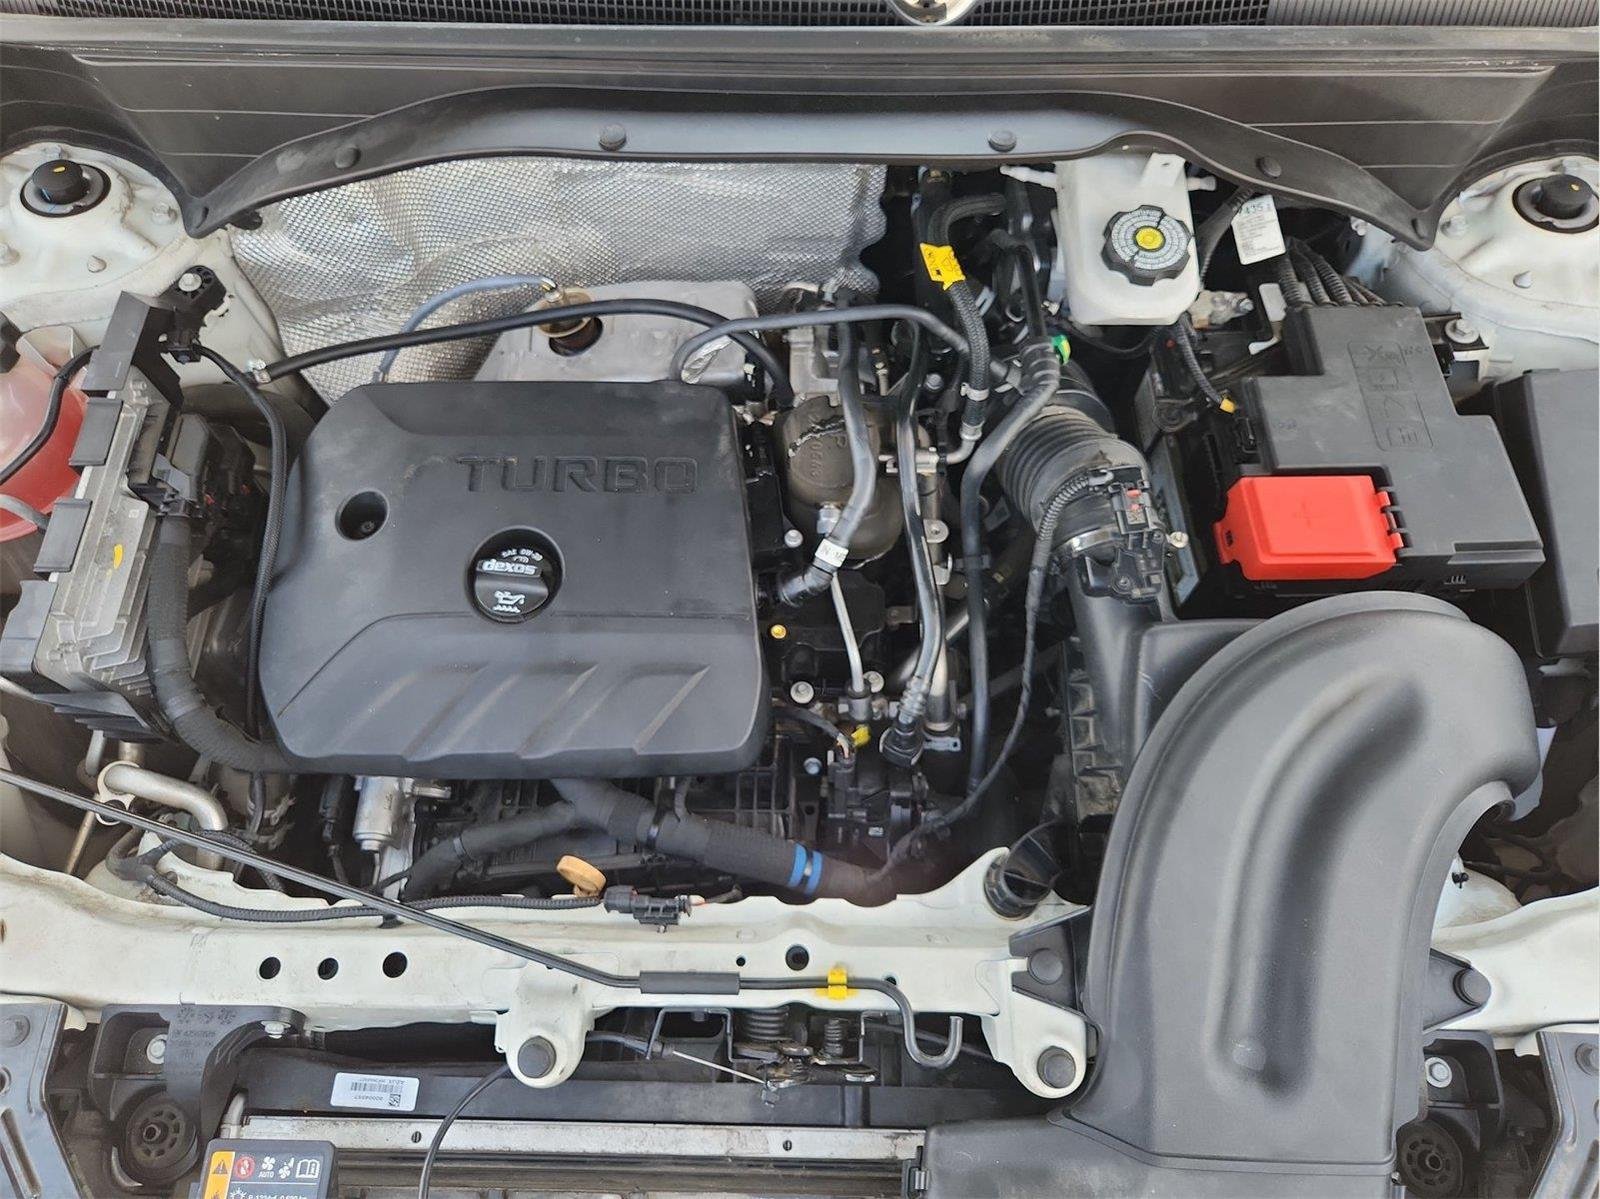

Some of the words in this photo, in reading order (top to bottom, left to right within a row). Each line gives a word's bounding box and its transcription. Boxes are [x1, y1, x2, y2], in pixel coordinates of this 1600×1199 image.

[456, 455, 698, 493] TURBO
[482, 558, 538, 575] dexos
[258, 1170, 275, 1178] AUTO
